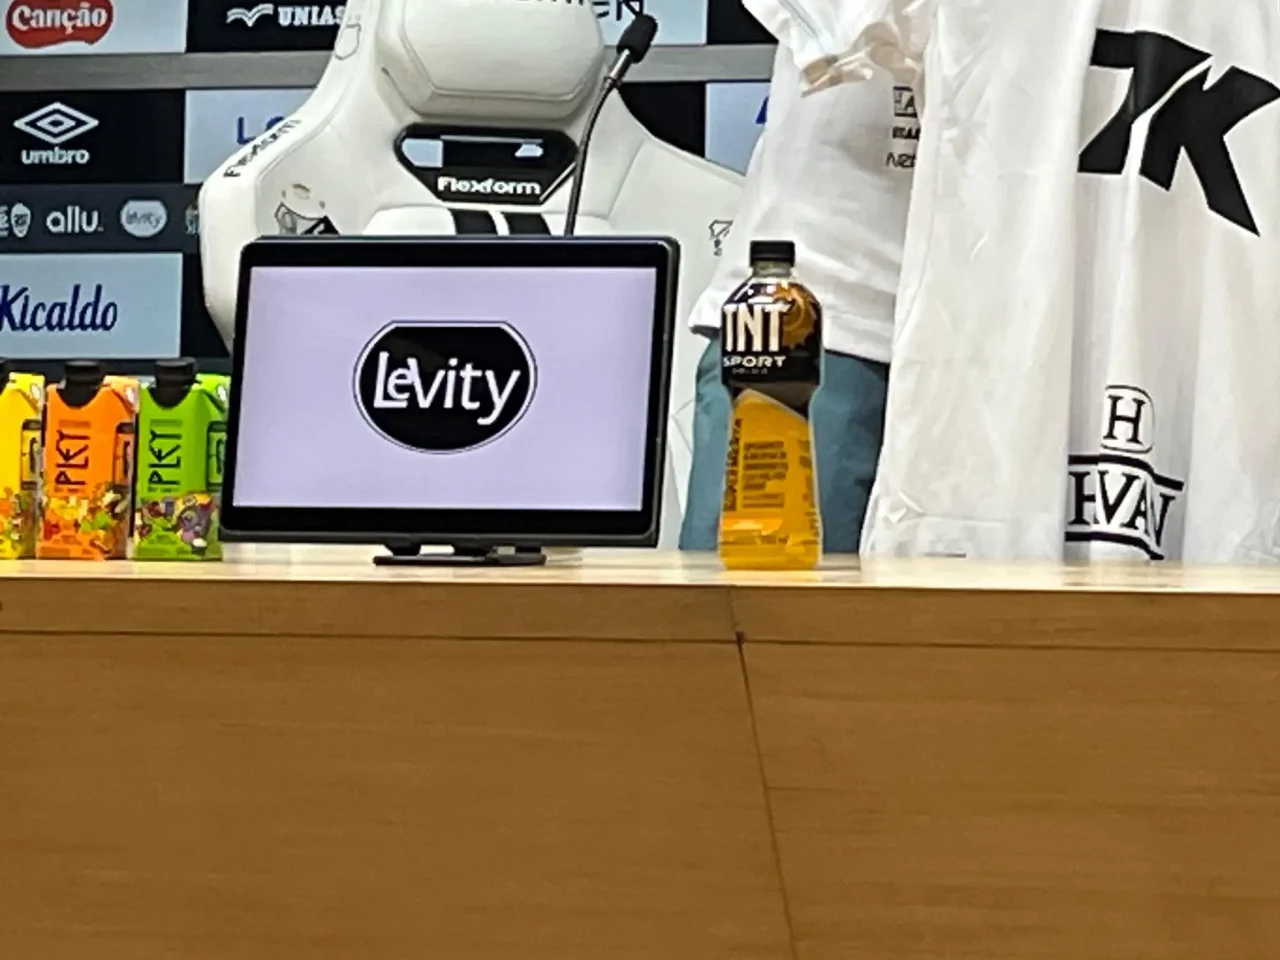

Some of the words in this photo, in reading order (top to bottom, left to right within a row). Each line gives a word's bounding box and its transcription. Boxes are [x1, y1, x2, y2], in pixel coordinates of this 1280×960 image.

[11, 0, 108, 34] Canção
[21, 147, 90, 165] umbro
[437, 176, 541, 196] Flexform
[723, 302, 792, 353] TNT
[723, 355, 787, 368] SPORT
[1102, 394, 1147, 446] H
